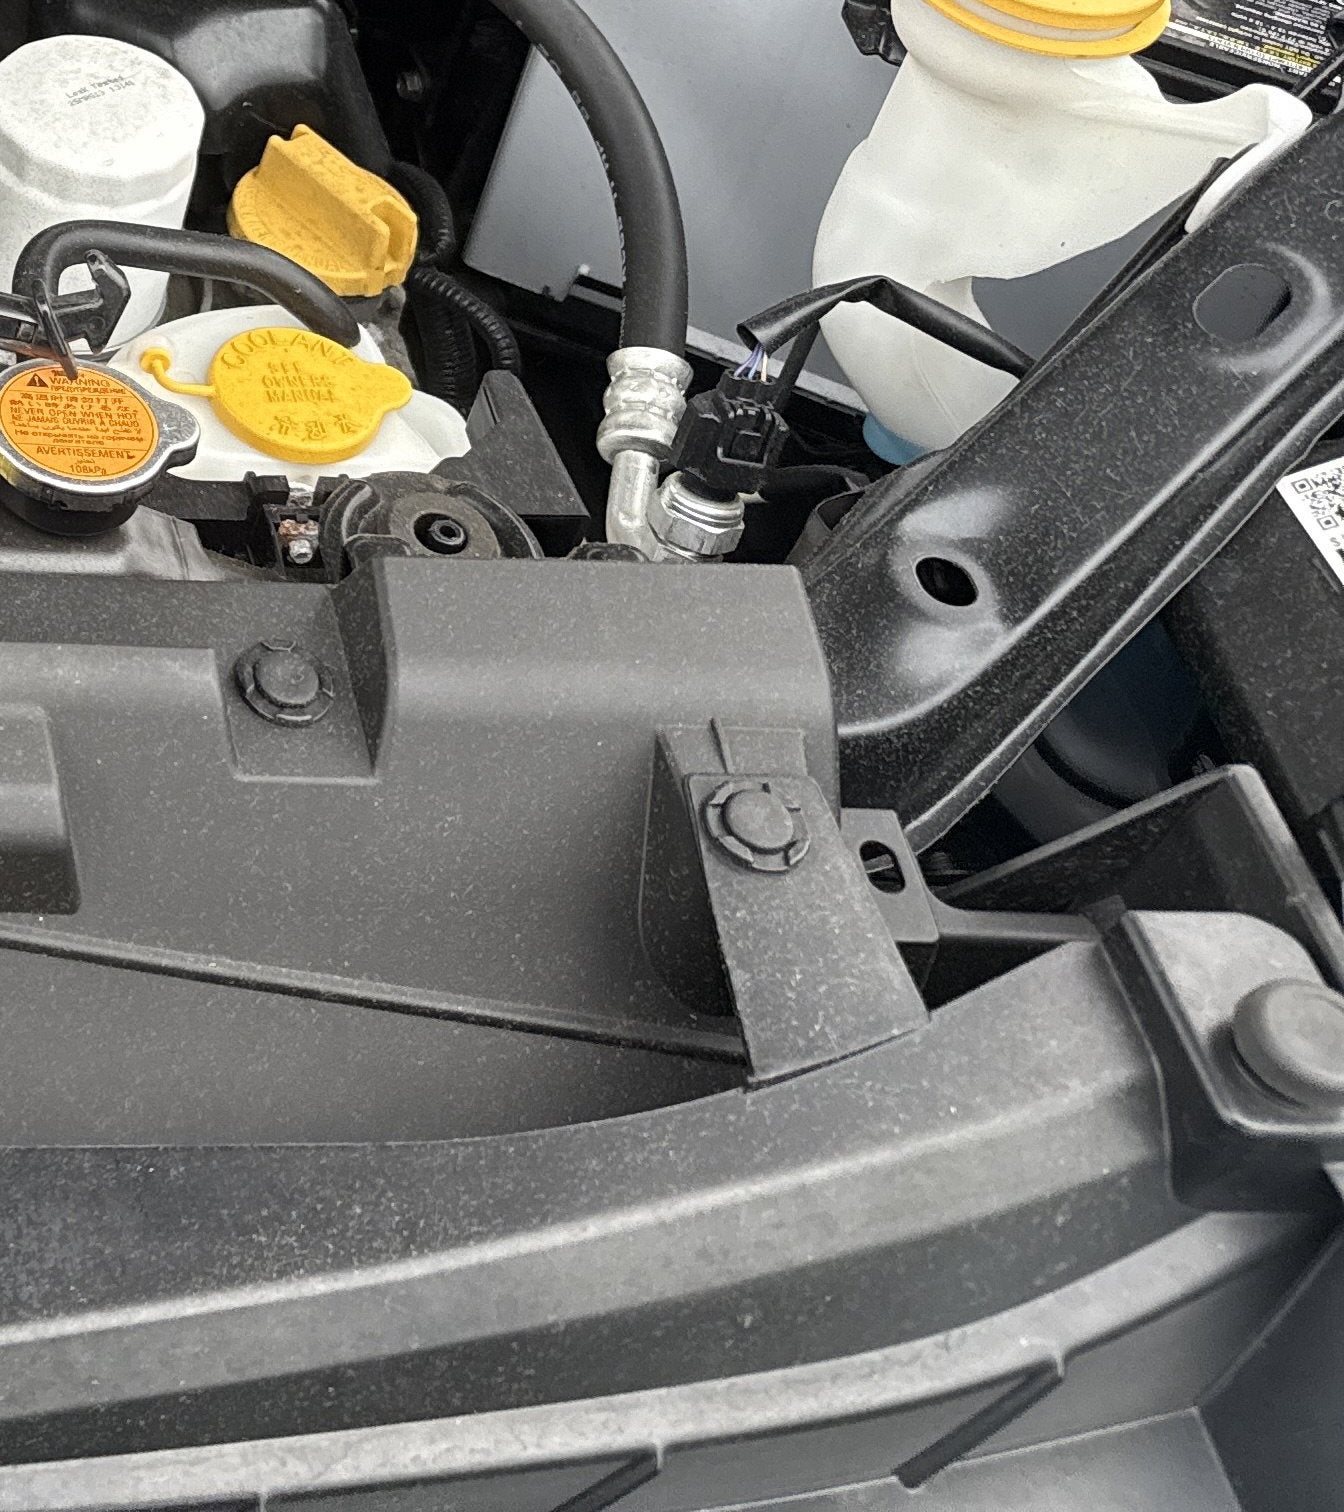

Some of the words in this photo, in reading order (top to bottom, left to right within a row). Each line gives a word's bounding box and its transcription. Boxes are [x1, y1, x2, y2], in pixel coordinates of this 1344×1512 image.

[220, 329, 354, 370] COOLANT
[10, 406, 45, 416] NEVER
[48, 408, 77, 417] OPEN
[80, 410, 113, 420] WHEN
[116, 412, 138, 421] HOT
[108, 419, 140, 428] CHAUD
[36, 445, 132, 459] AVERTISSEMENT
